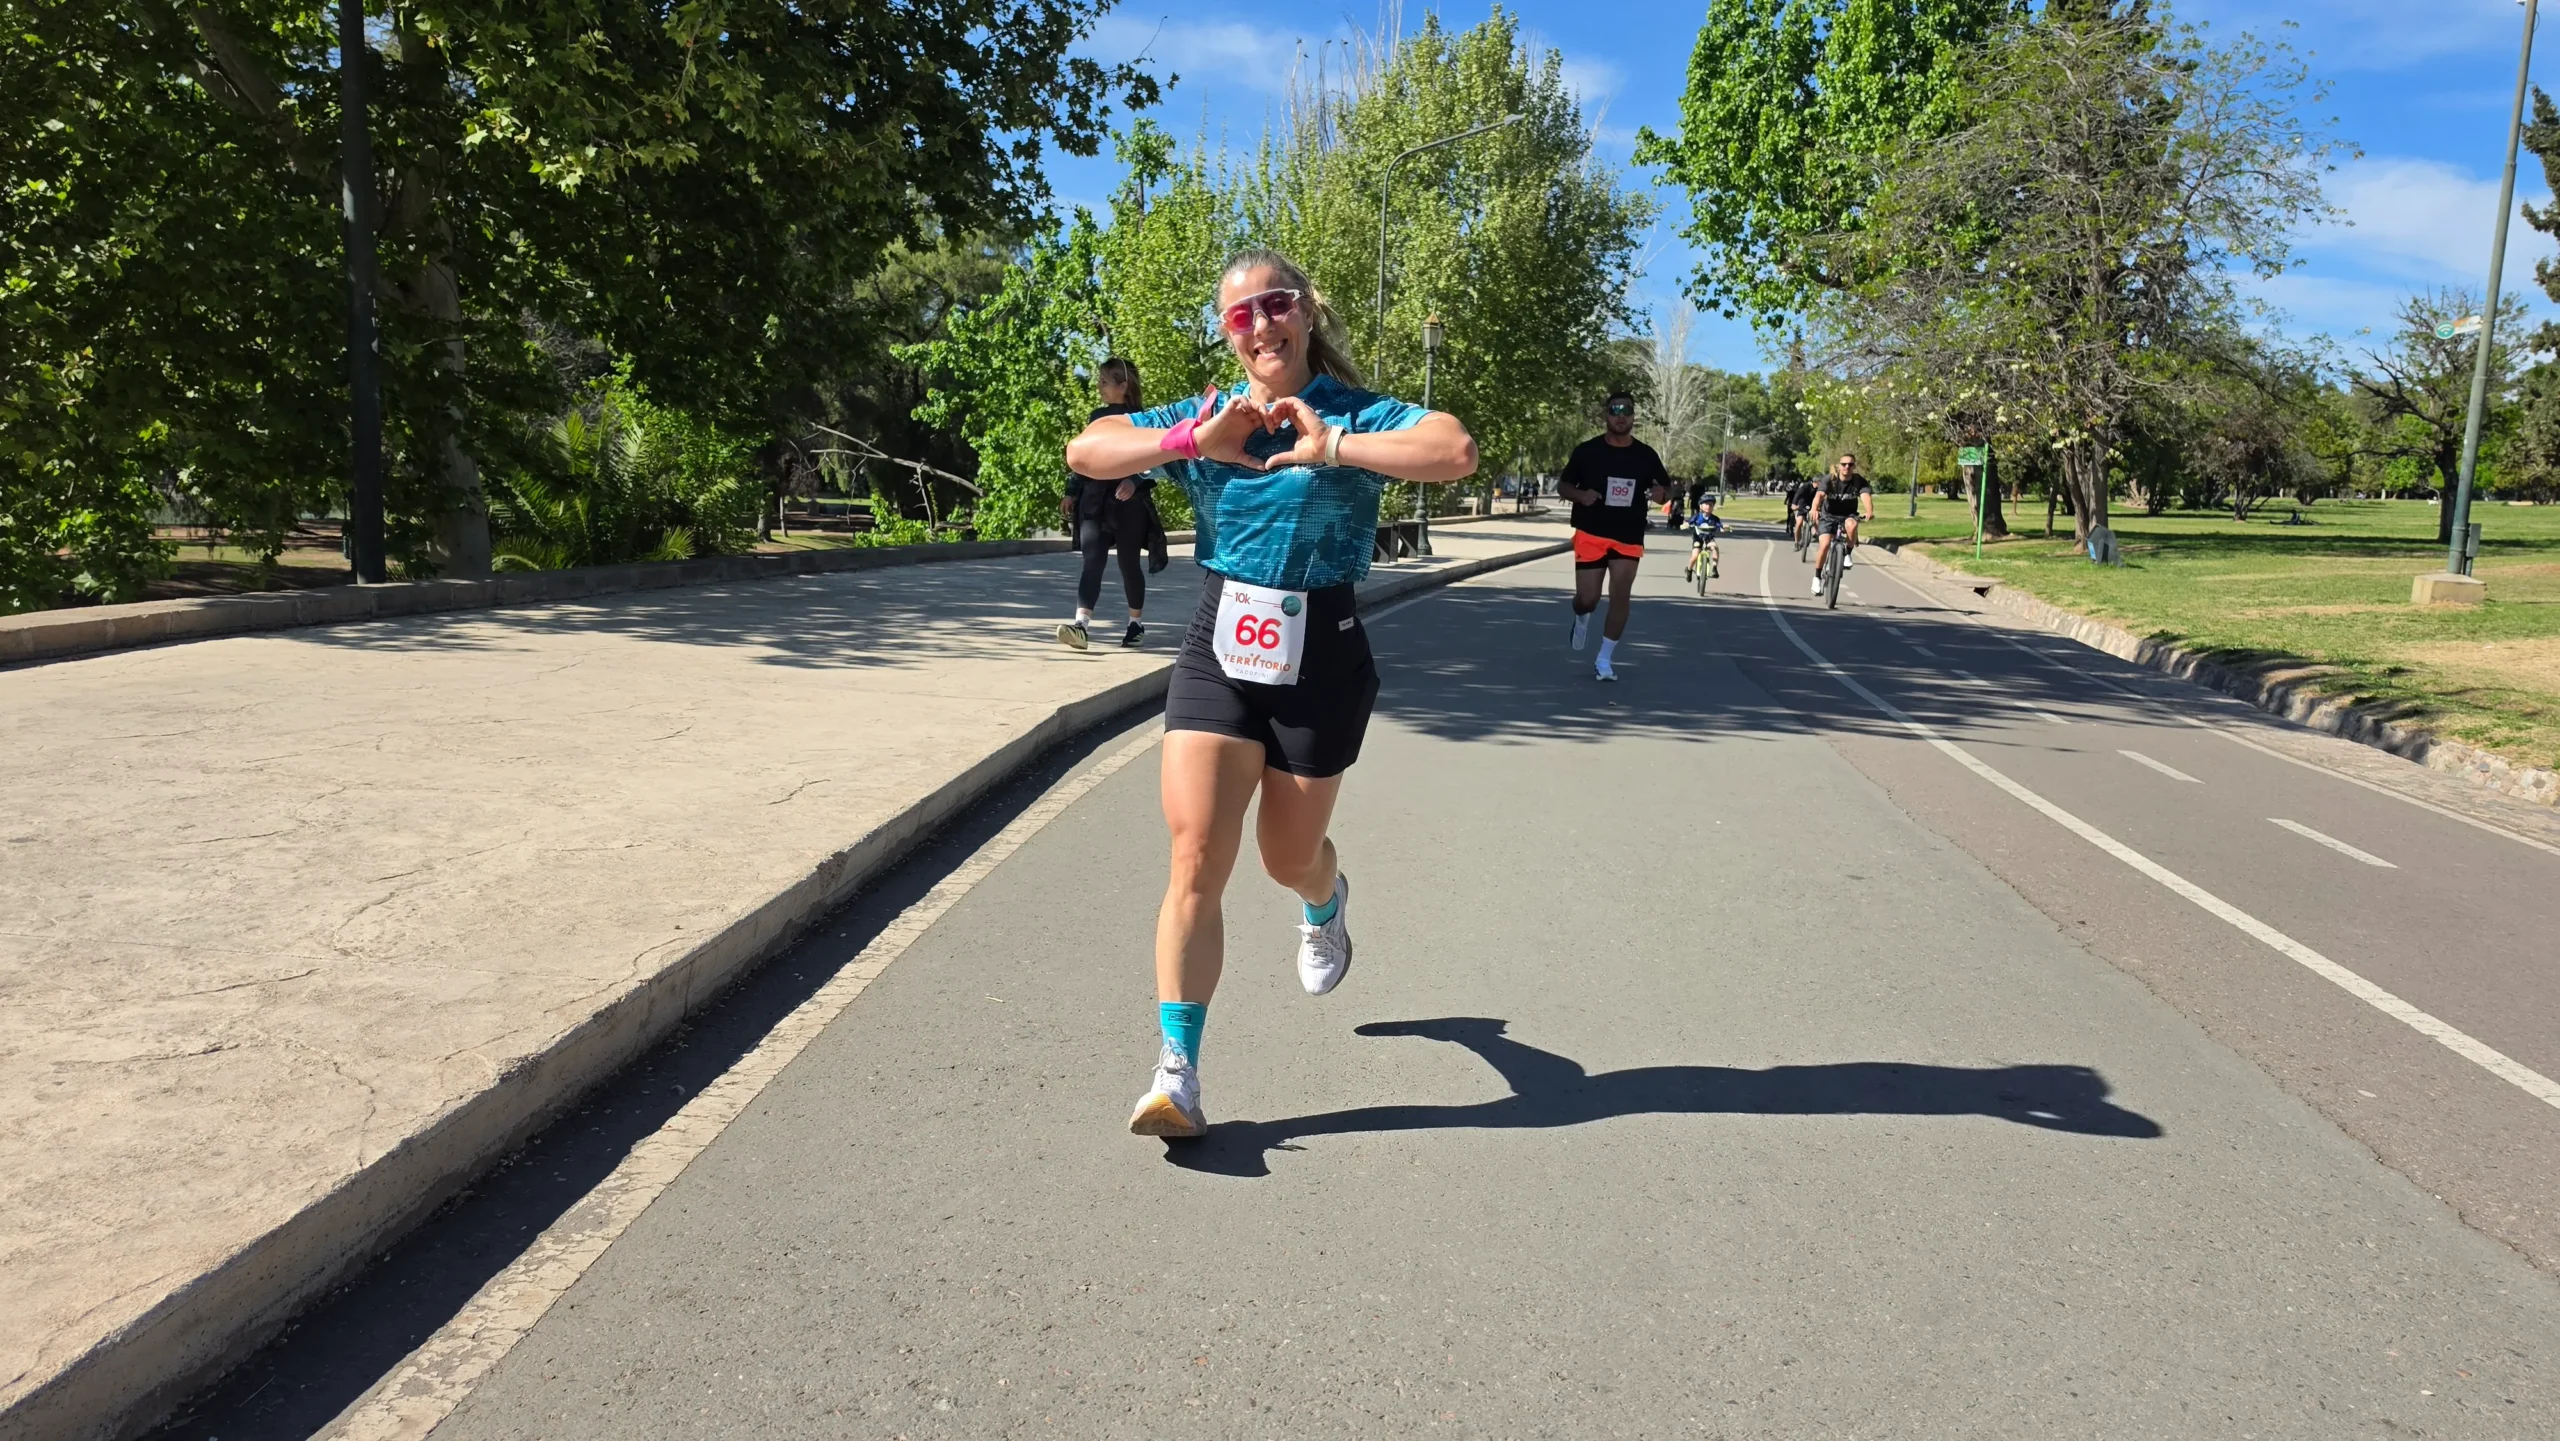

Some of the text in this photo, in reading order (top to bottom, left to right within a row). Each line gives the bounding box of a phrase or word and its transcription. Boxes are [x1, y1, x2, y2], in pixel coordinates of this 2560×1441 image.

[1612, 486, 1629, 497] 199
[1235, 592, 1251, 605] 10k
[1235, 614, 1282, 650] 66
[1223, 652, 1291, 672] TERRITORIO
